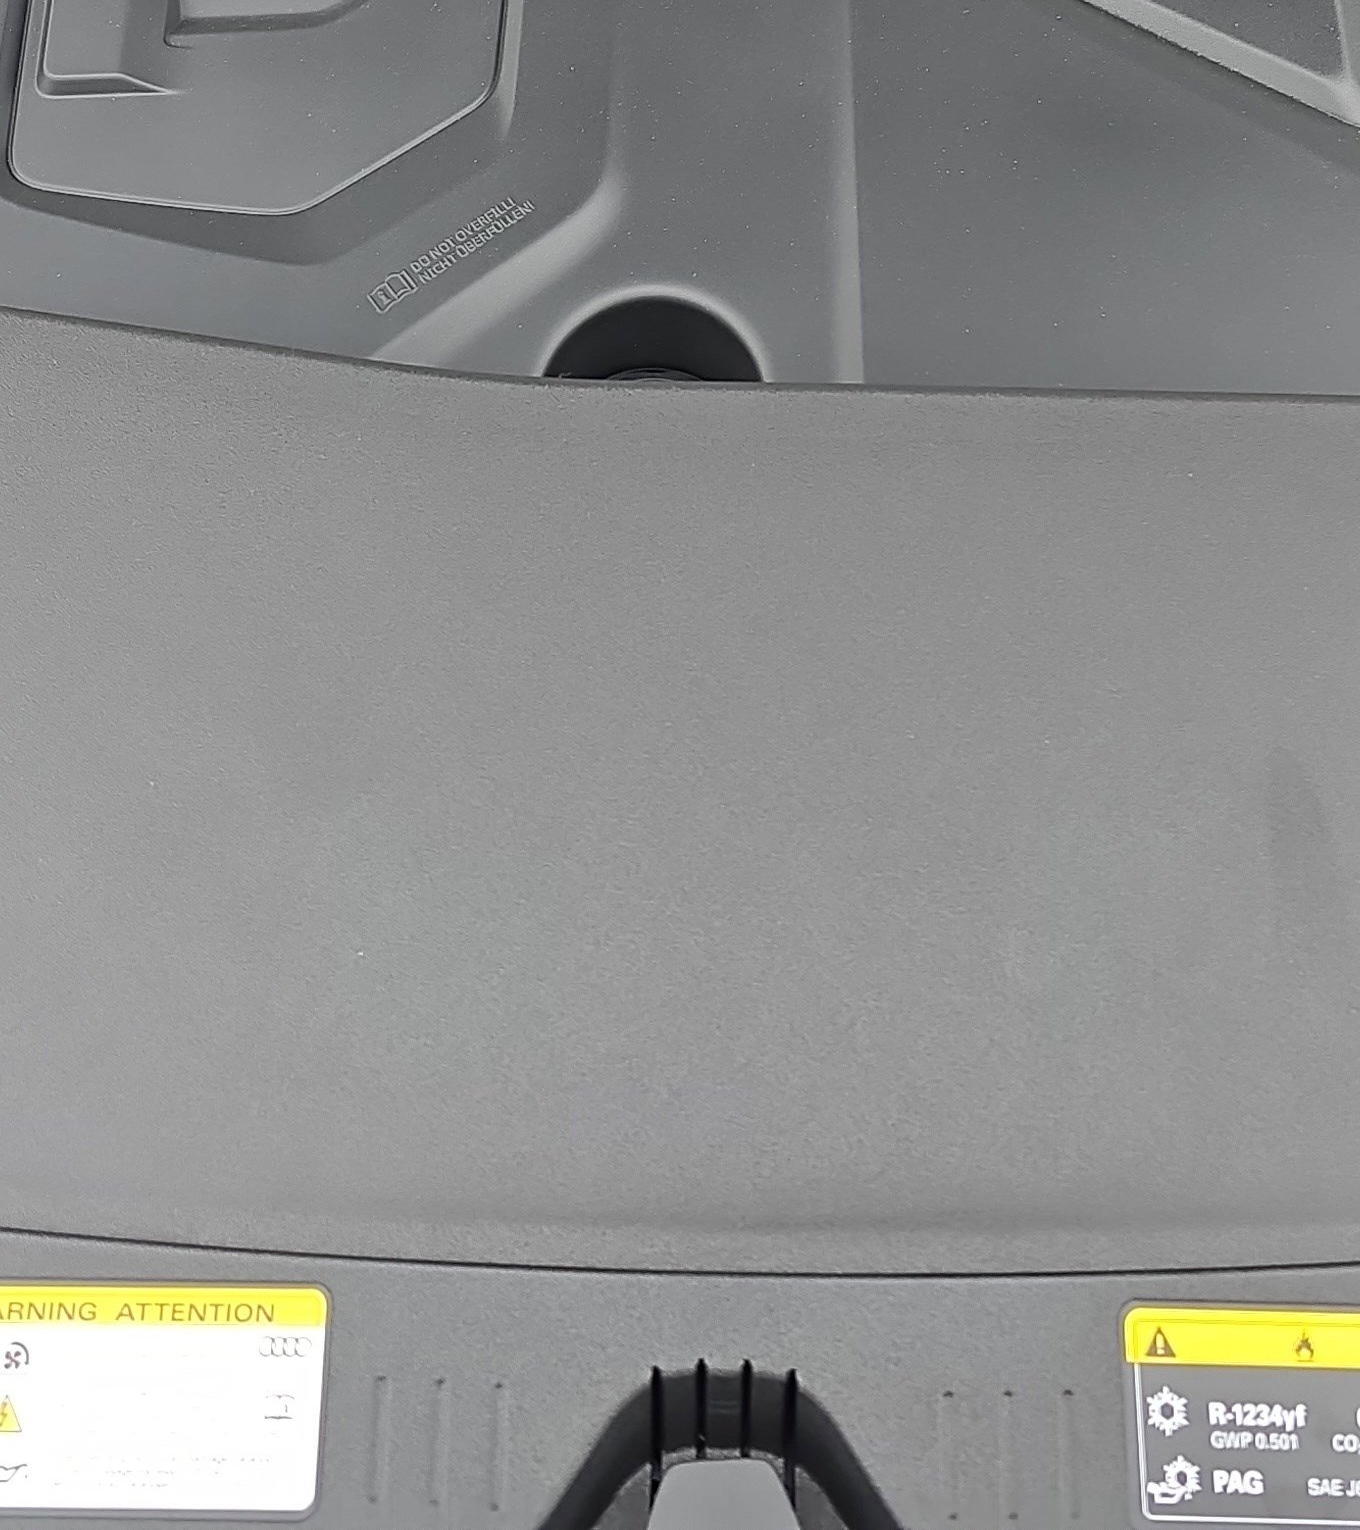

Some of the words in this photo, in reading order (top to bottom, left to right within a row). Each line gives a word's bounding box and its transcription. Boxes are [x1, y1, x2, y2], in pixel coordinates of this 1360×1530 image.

[410, 254, 431, 273] DO
[429, 236, 456, 260] NOT
[418, 252, 458, 285] NICHT
[115, 1302, 275, 1322] ATTENTION
[1208, 1401, 1308, 1432] R-1234yf
[1210, 1430, 1253, 1449] GWP
[1255, 1432, 1299, 1450] 0.501
[1212, 1469, 1264, 1494] PAG
[1307, 1477, 1344, 1497] SAE
